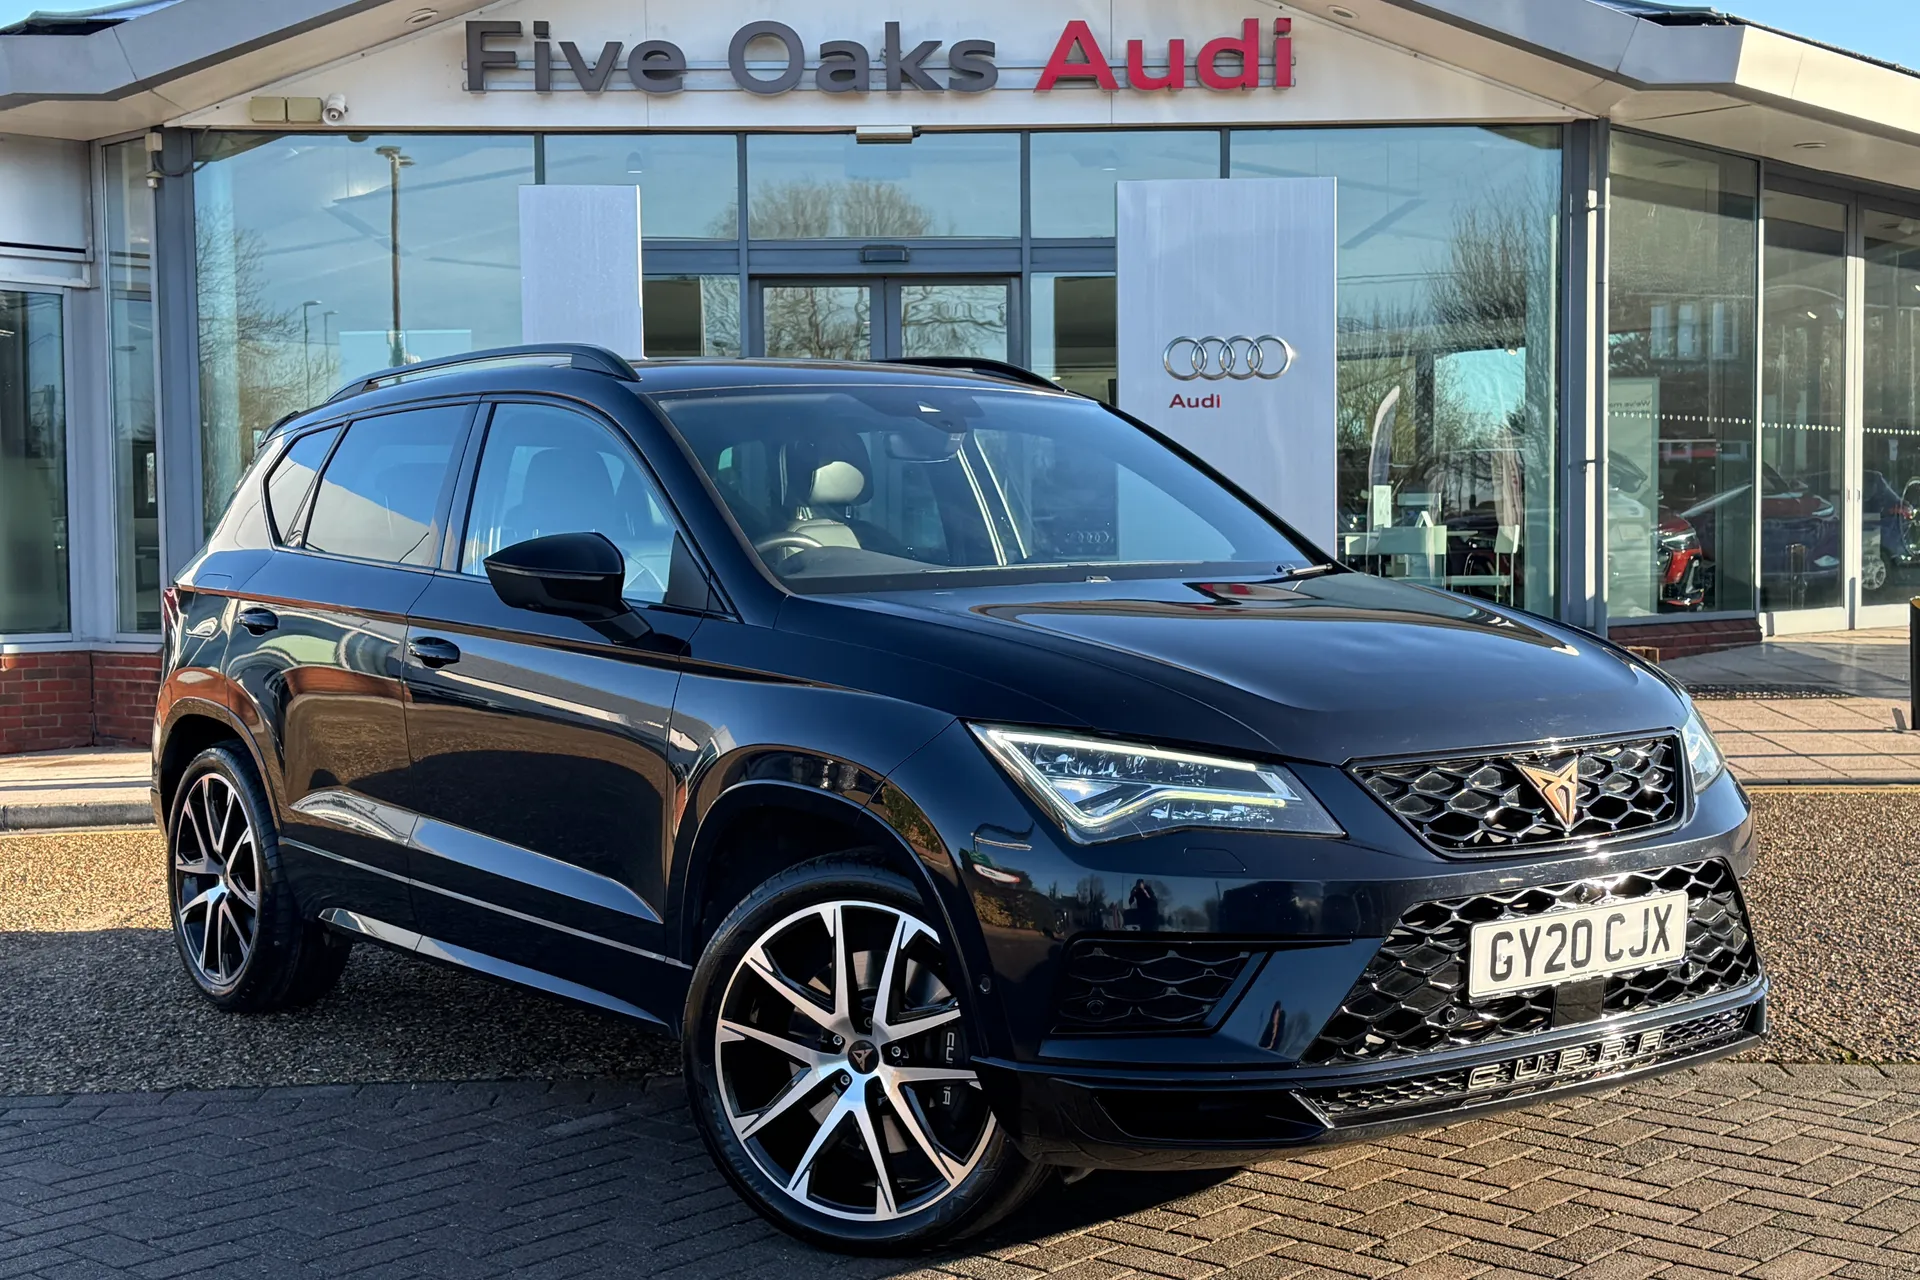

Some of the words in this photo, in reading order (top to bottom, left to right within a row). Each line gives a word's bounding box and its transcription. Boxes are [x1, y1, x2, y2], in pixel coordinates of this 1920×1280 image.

[465, 20, 687, 94] Five
[728, 20, 999, 95] Oaks
[1033, 17, 1292, 92] Audi
[1169, 393, 1220, 408] Audi
[1490, 918, 1592, 982] GY20
[1604, 903, 1673, 962] CJX
[942, 1032, 955, 1105] CUA
[1468, 1029, 1665, 1088] CUPRA
